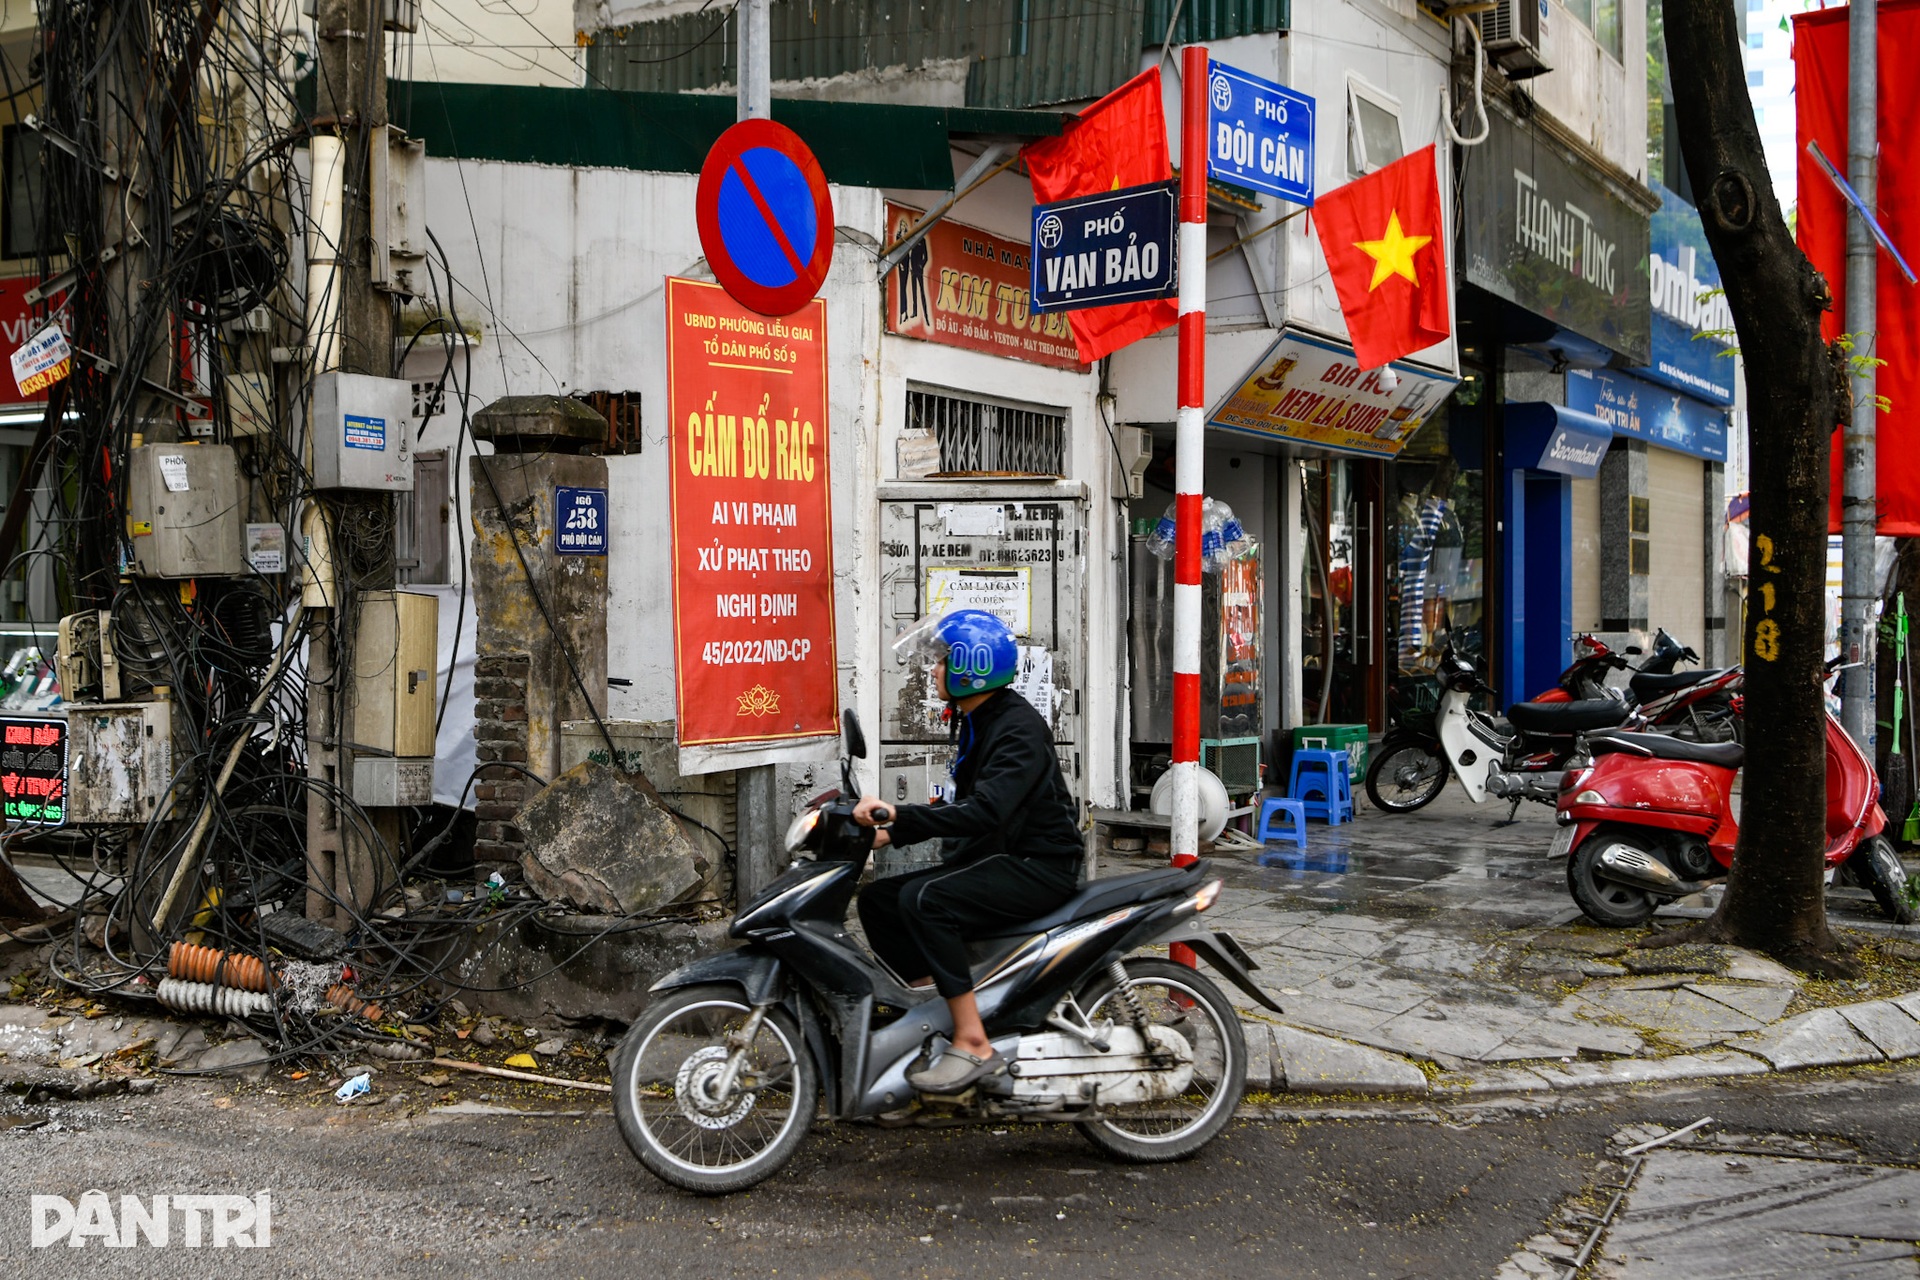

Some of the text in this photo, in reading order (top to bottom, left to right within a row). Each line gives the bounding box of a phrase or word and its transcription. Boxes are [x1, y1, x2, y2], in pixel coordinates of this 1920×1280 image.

[1255, 97, 1288, 124] PHỐ
[1217, 120, 1304, 184] ĐỘI CẤN
[1084, 206, 1126, 239] PHỐ
[963, 238, 1031, 270] NHÀ MAY
[1045, 232, 1159, 298] VẠN BẢO
[936, 269, 992, 321] KIM
[684, 312, 813, 342] UBND PHƯỜNG LIỄU GIAI
[703, 334, 797, 364] TỔ DÂN PHỐ SỐ 9
[993, 331, 1021, 347] VESTON
[1023, 338, 1038, 352] MAY
[1038, 341, 1055, 355] THEO
[1319, 362, 1361, 388] BIA
[1269, 387, 1390, 434] NEM LÁ SUNG
[1617, 410, 1628, 429] TRI
[687, 390, 815, 483] CẤM ĐỔ RÁC
[1551, 433, 1602, 467] Sacombank
[565, 507, 598, 530] 258
[711, 501, 797, 534] AI VI PHẠM
[561, 531, 603, 547] PHỐ ĐỘI CẤN
[932, 544, 946, 557] XE
[698, 537, 812, 579] XỬ PHẠT THEO
[950, 578, 973, 591] CẤM
[969, 595, 981, 604] CÓ
[716, 594, 797, 624] NGHỊ ĐỊNH
[702, 639, 811, 667] 45/2022/NĐ-CP
